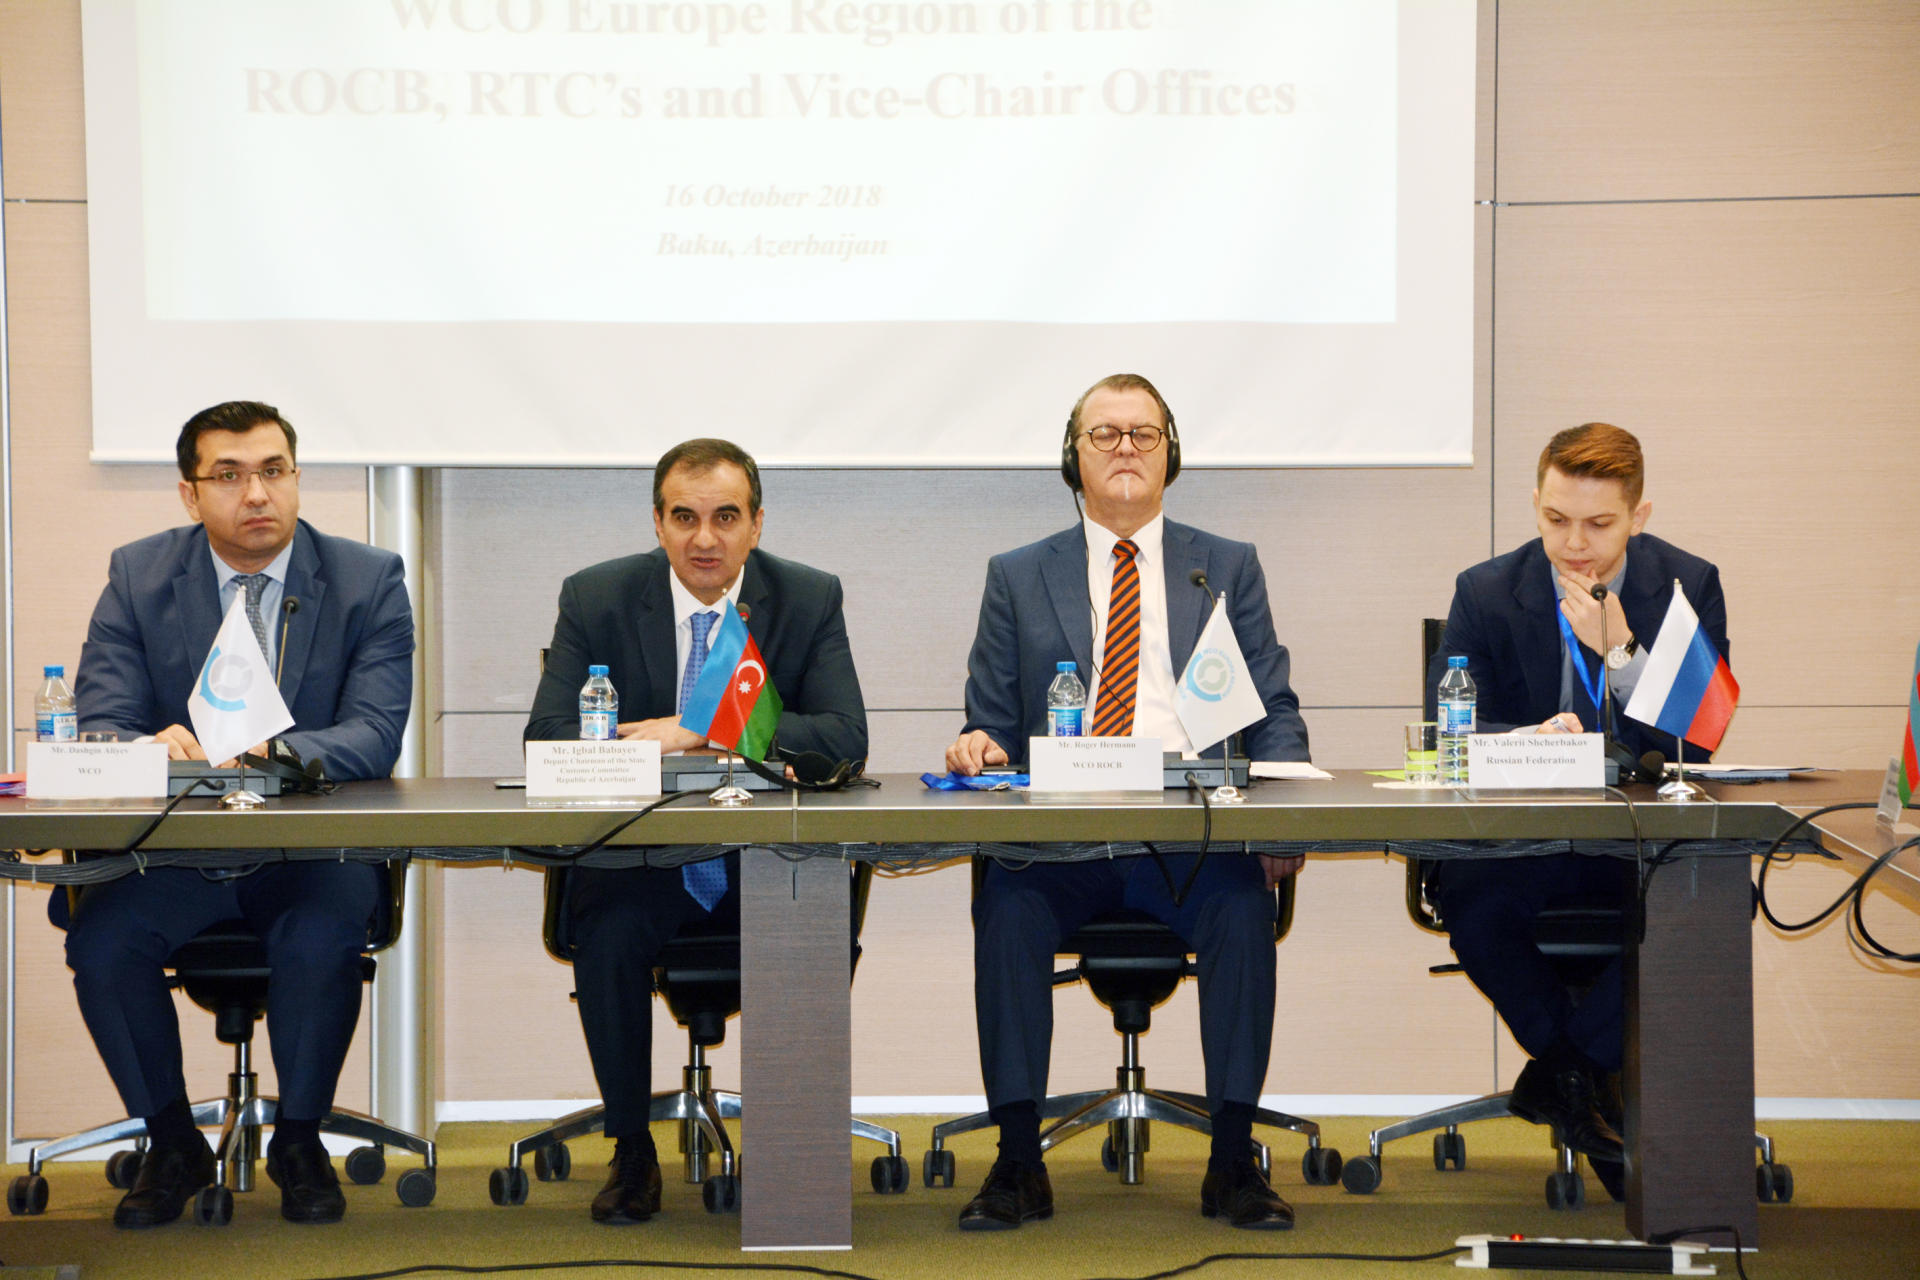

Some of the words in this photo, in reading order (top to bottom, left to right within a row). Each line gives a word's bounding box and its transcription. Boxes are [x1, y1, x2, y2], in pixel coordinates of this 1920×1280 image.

[390, 0, 545, 33] WCO
[567, 0, 767, 46] Europe
[788, 0, 979, 46] Region
[1000, 0, 1049, 34] of
[1071, 0, 1153, 31] the
[242, 67, 449, 124] ROCB,
[663, 73, 764, 119] and
[782, 70, 1085, 119] Vice-Chair
[1101, 67, 1296, 116] Offices
[663, 184, 696, 208] 16
[702, 184, 809, 208] October
[816, 184, 882, 208] 2018
[656, 232, 735, 259] Baku,
[744, 232, 888, 262] Azerbaijan
[1058, 741, 1072, 749] Mr.
[1075, 741, 1097, 750] Roger
[1473, 738, 1490, 747] Mr.
[51, 746, 66, 754] Mr.
[552, 746, 569, 755] Mr.
[1486, 756, 1522, 764] Russian
[1526, 755, 1576, 764] Federation
[1072, 761, 1094, 769] WCO
[1097, 761, 1123, 769] ROCB
[78, 767, 102, 775] WCO
